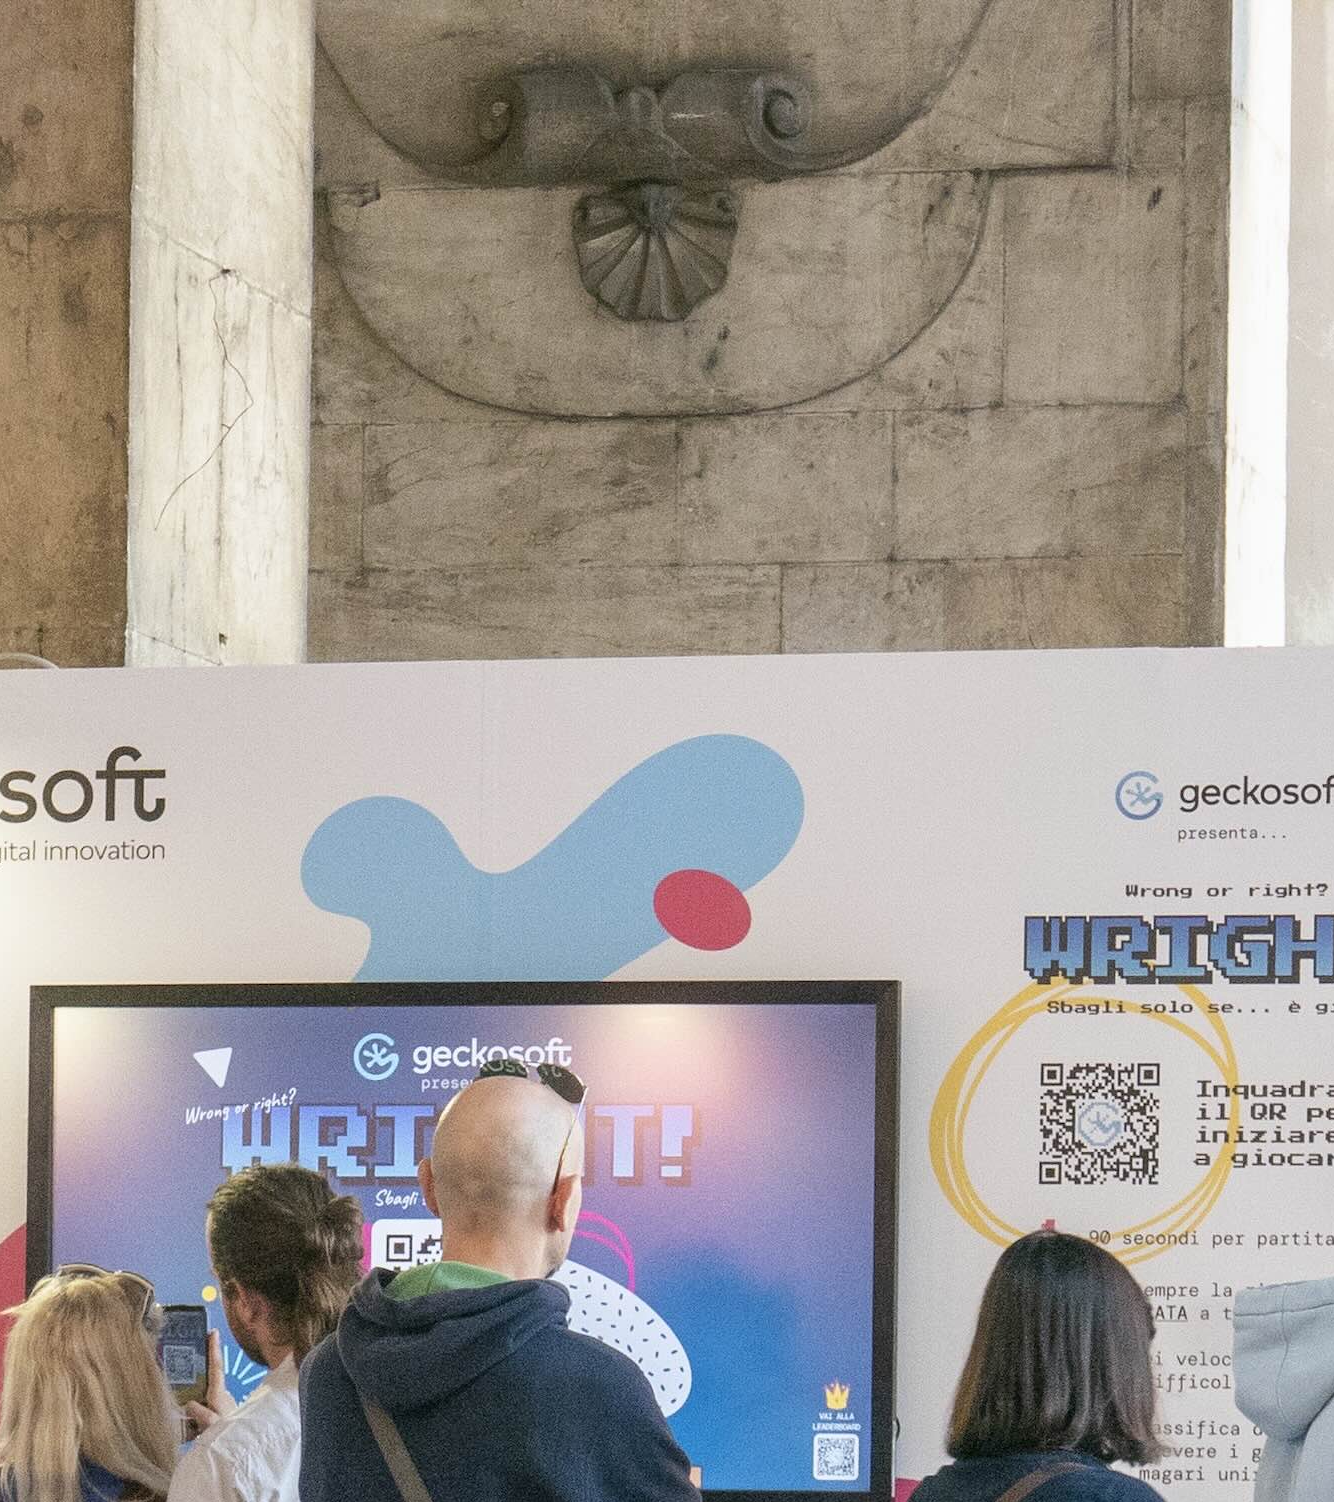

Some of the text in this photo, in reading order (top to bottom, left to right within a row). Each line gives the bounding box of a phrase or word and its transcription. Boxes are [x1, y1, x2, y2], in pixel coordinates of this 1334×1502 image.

[1178, 828, 1288, 843] presenta...
[44, 839, 166, 862] innovation
[1125, 883, 1329, 899] Wrong or right?
[1046, 1000, 1126, 1015] Sbagli
[1140, 1001, 1194, 1014] solo
[1207, 1003, 1270, 1014] se...
[1288, 1000, 1301, 1014] è
[412, 1037, 572, 1074] geckosoft
[421, 1078, 473, 1092] prese
[186, 1087, 297, 1124] Wrong or right?
[1196, 1103, 1230, 1120] il
[1250, 1103, 1286, 1120] QR
[222, 1104, 701, 1184] WRIT!
[1194, 1153, 1211, 1166] a
[375, 1188, 419, 1210] Sbagli
[1089, 1230, 1111, 1245] 90
[1123, 1230, 1199, 1246] secondi
[1212, 1233, 1245, 1249] per
[1211, 1283, 1233, 1297] la
[836, 1412, 855, 1420] ALLA
[1139, 1465, 1204, 1484] magari
